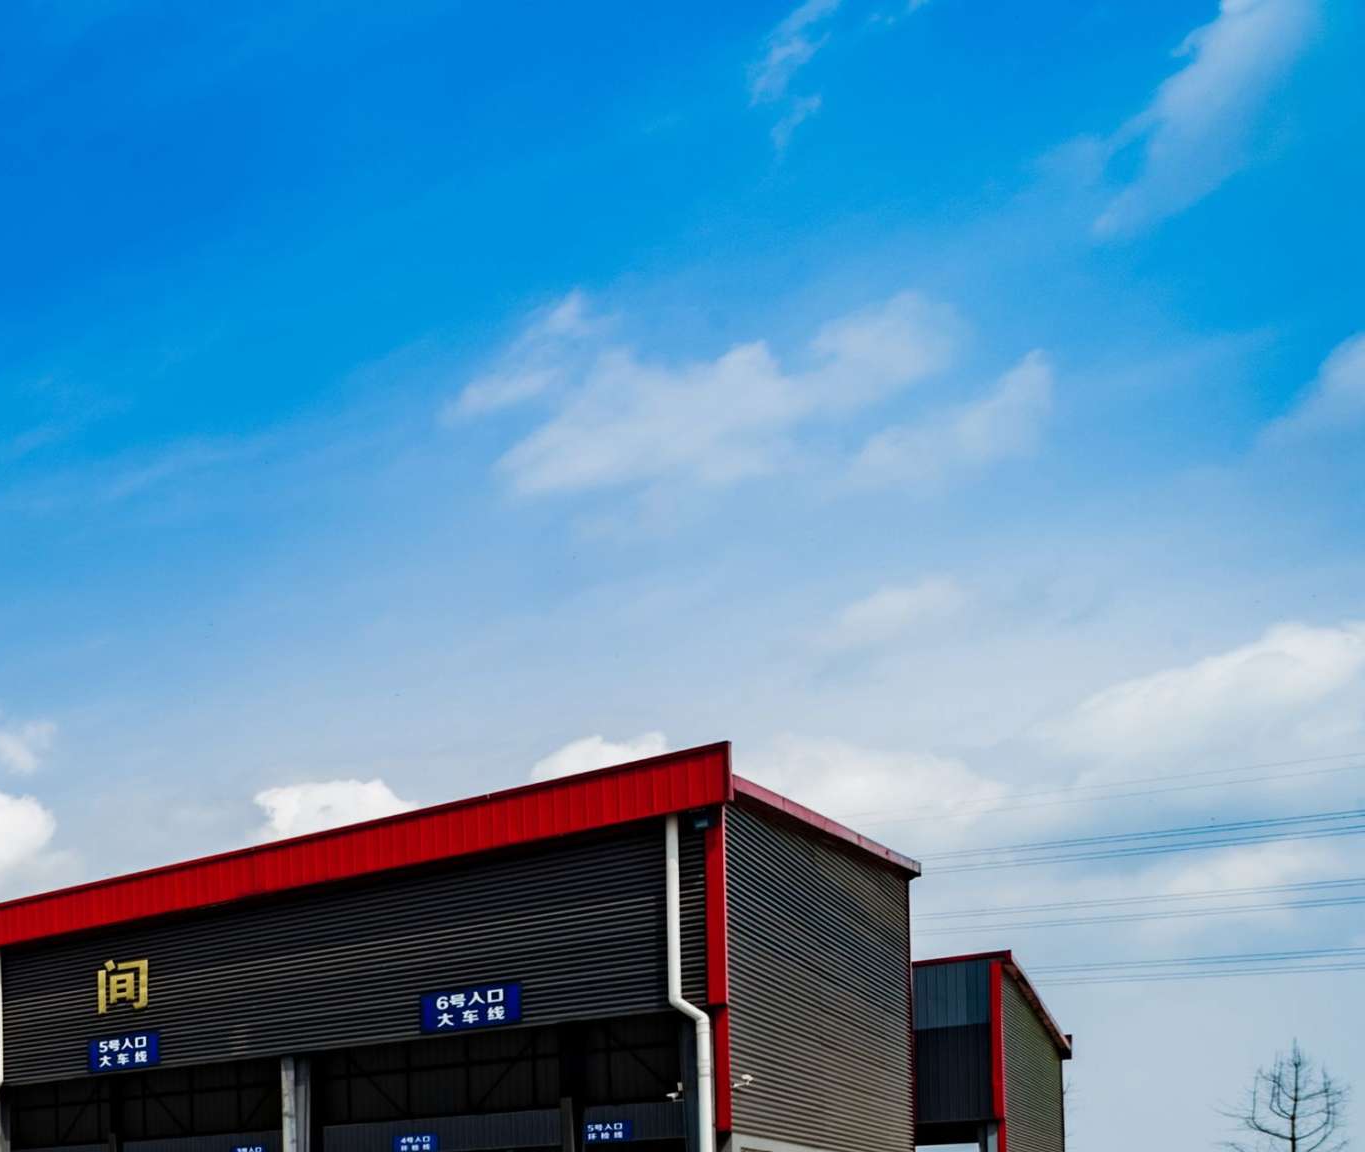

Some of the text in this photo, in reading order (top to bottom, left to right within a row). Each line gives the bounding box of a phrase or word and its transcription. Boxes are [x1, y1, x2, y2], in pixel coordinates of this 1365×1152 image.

[435, 988, 504, 1010] 6号入口
[436, 1005, 505, 1028] 大车线
[98, 1036, 147, 1053] 5号入口
[98, 1051, 148, 1068] 大车线
